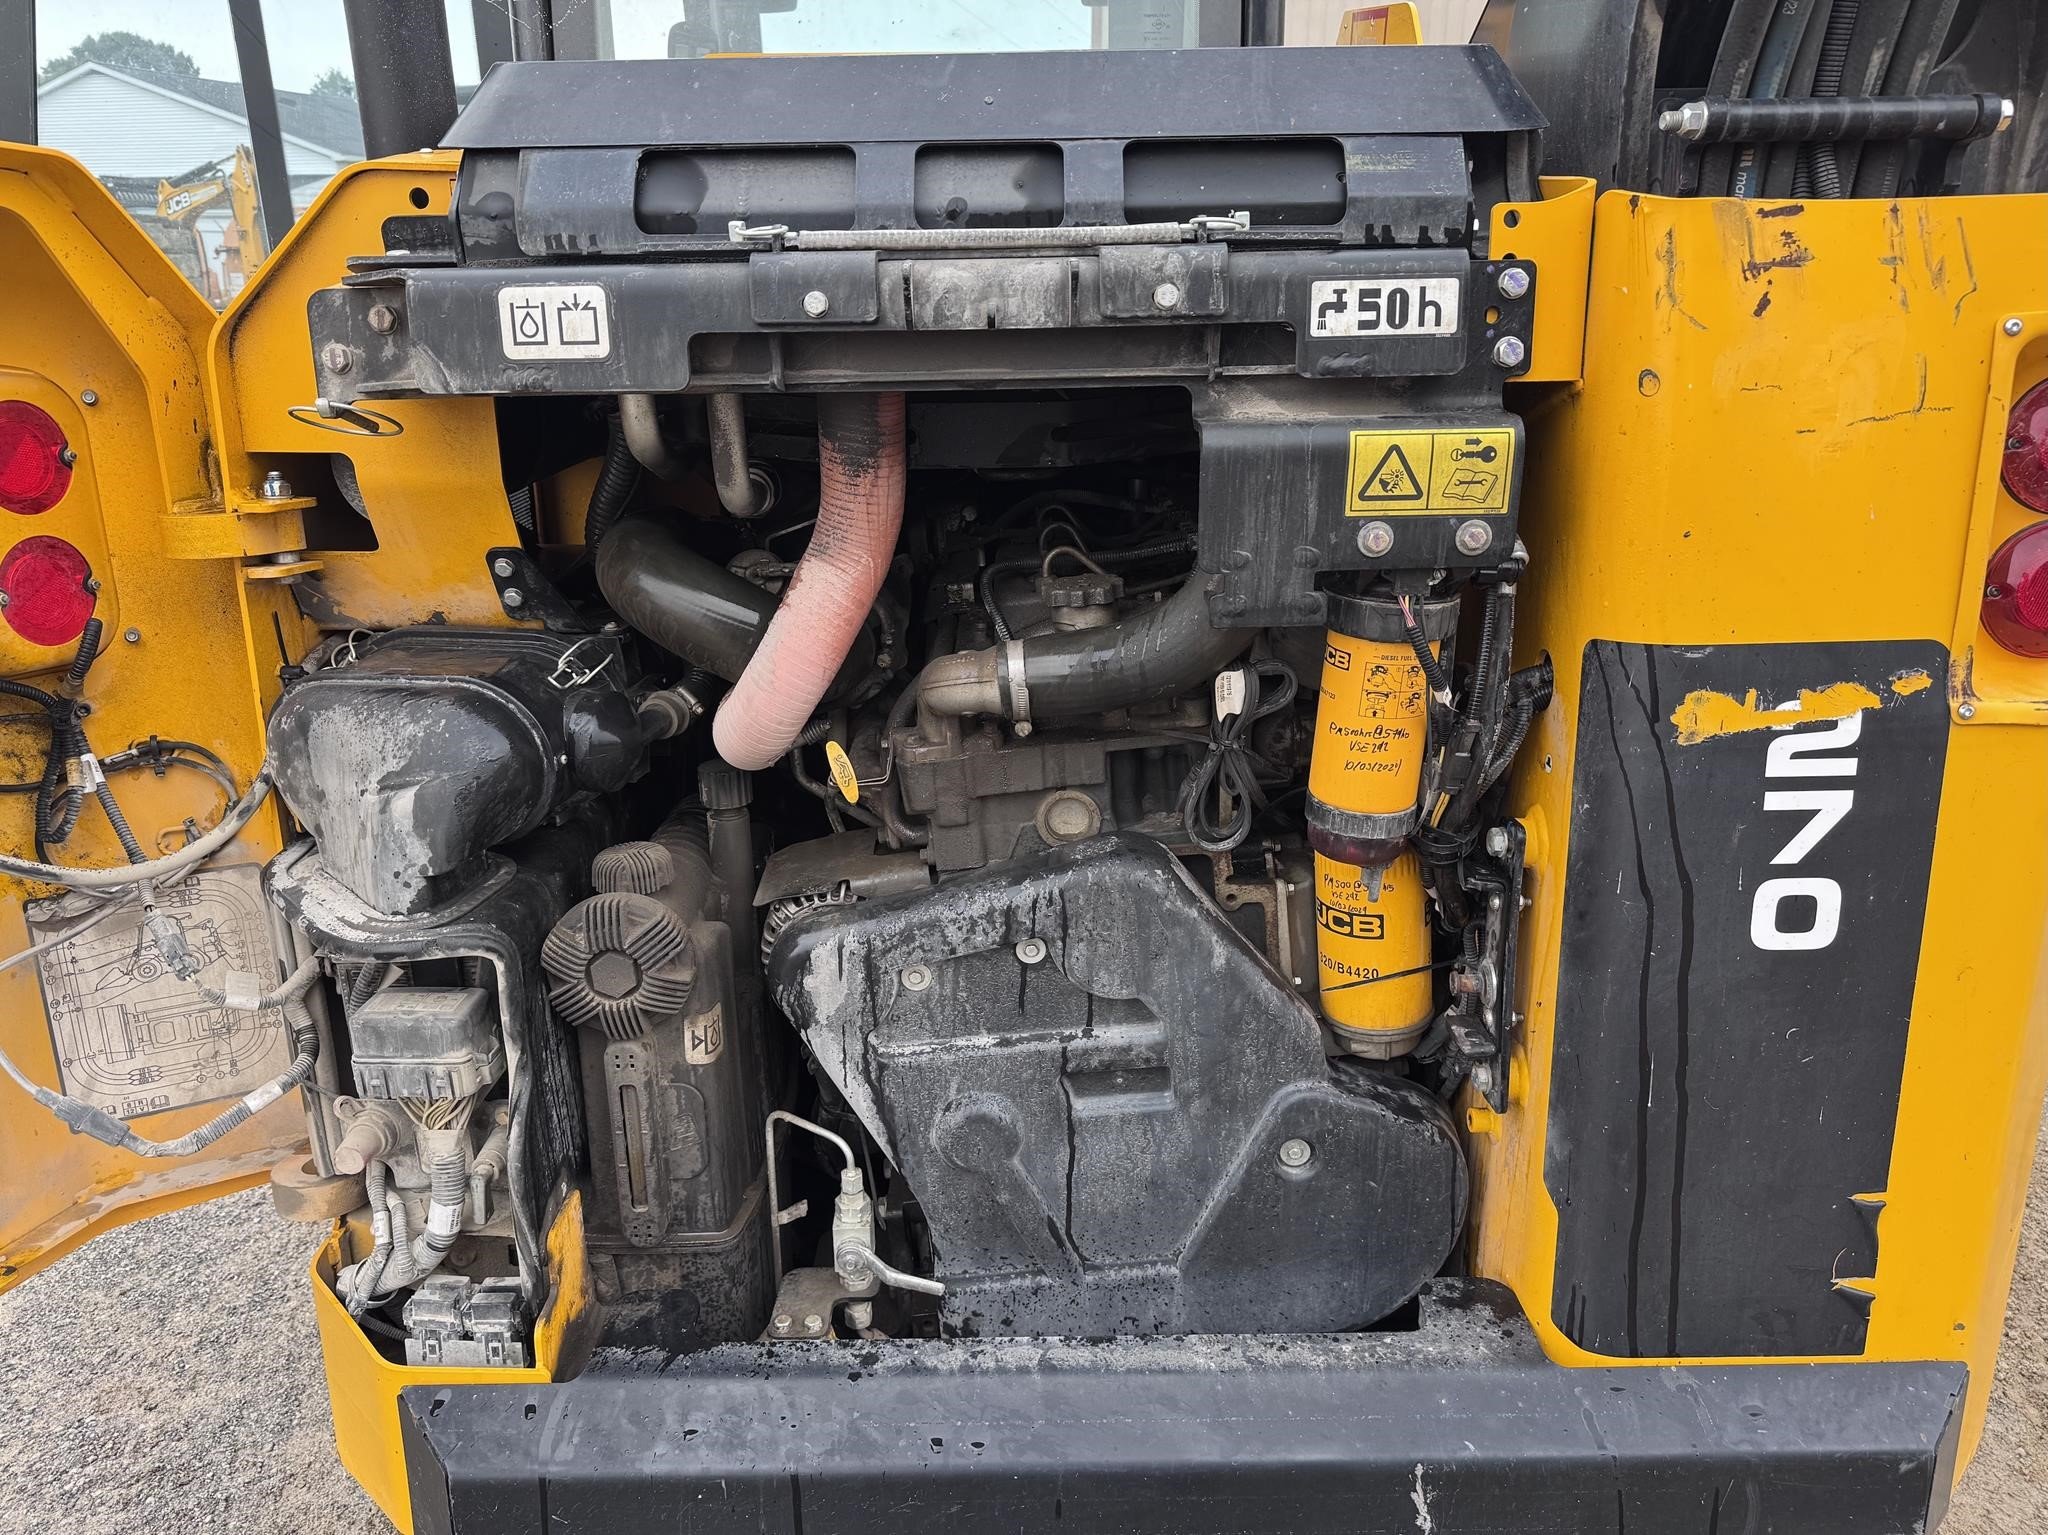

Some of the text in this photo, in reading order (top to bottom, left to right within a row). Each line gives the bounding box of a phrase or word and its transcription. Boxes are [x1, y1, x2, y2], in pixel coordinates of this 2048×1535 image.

[165, 192, 191, 215] JCB
[1326, 645, 1350, 671] CB
[1317, 904, 1382, 938] JCB
